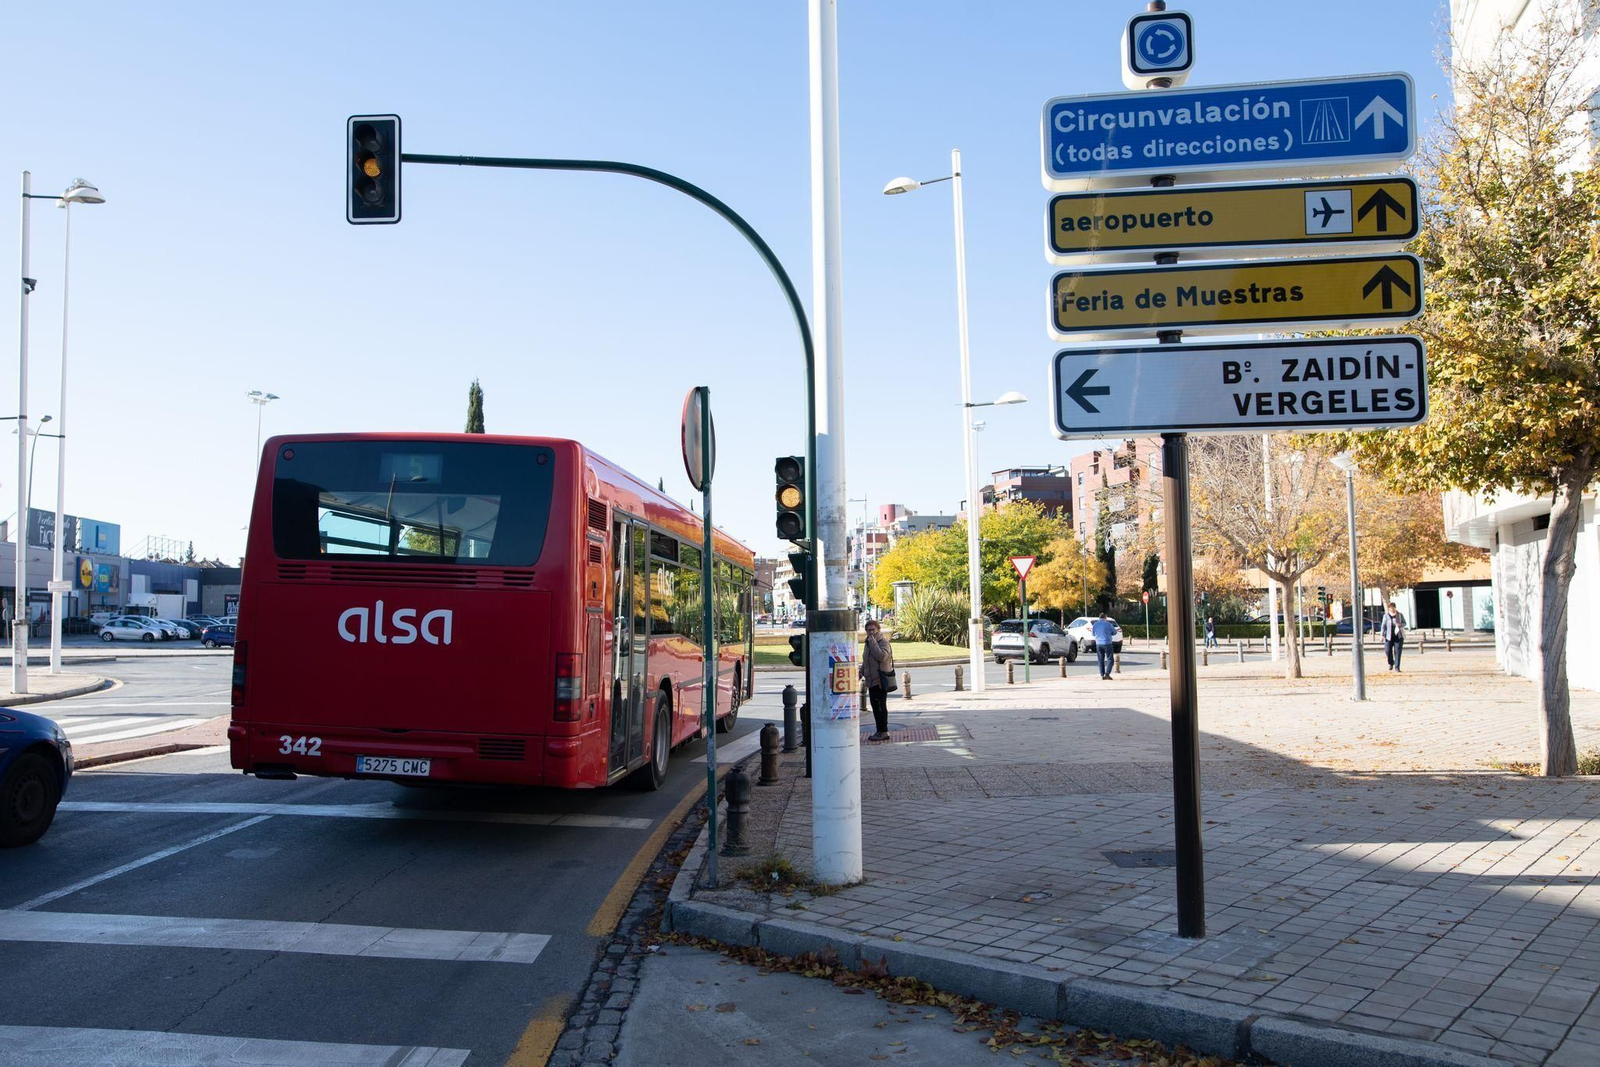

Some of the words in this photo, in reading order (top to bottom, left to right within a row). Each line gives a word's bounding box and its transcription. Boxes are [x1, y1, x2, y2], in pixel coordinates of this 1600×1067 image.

[1054, 97, 1291, 133] Circunvalación
[1055, 142, 1133, 165] (todas
[1143, 128, 1294, 158] direcciones)
[1060, 206, 1214, 233] aeropuerto
[1061, 290, 1125, 312] Feria
[1135, 287, 1166, 310] de
[1176, 283, 1304, 307] Muestras
[1281, 350, 1414, 383] ZAIDÍN-
[1232, 387, 1416, 416] VERGELES
[657, 563, 675, 597] alsa
[338, 599, 453, 645] alsa
[835, 680, 851, 691] C1
[836, 668, 851, 678] B1
[278, 735, 322, 756] 342
[365, 758, 398, 772] 5275
[402, 760, 428, 774] CMC
